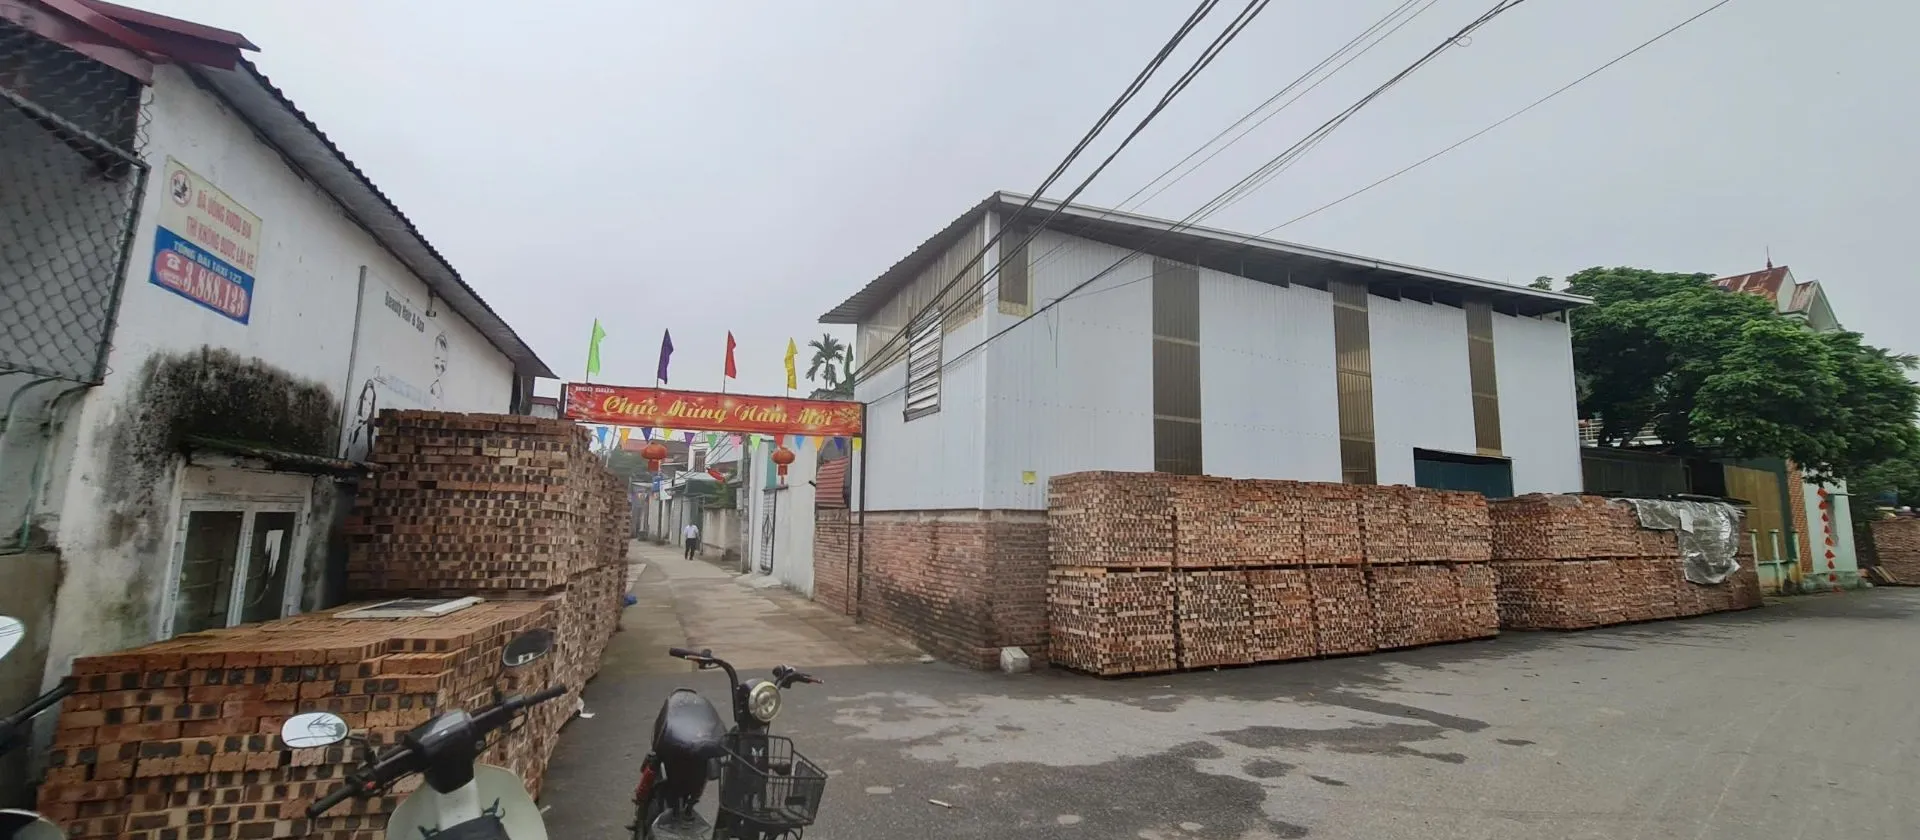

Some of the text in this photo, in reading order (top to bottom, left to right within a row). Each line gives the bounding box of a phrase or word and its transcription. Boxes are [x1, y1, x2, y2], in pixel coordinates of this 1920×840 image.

[603, 395, 658, 416] Chúc
[664, 399, 727, 423] Mừng
[735, 404, 788, 423] Năm
